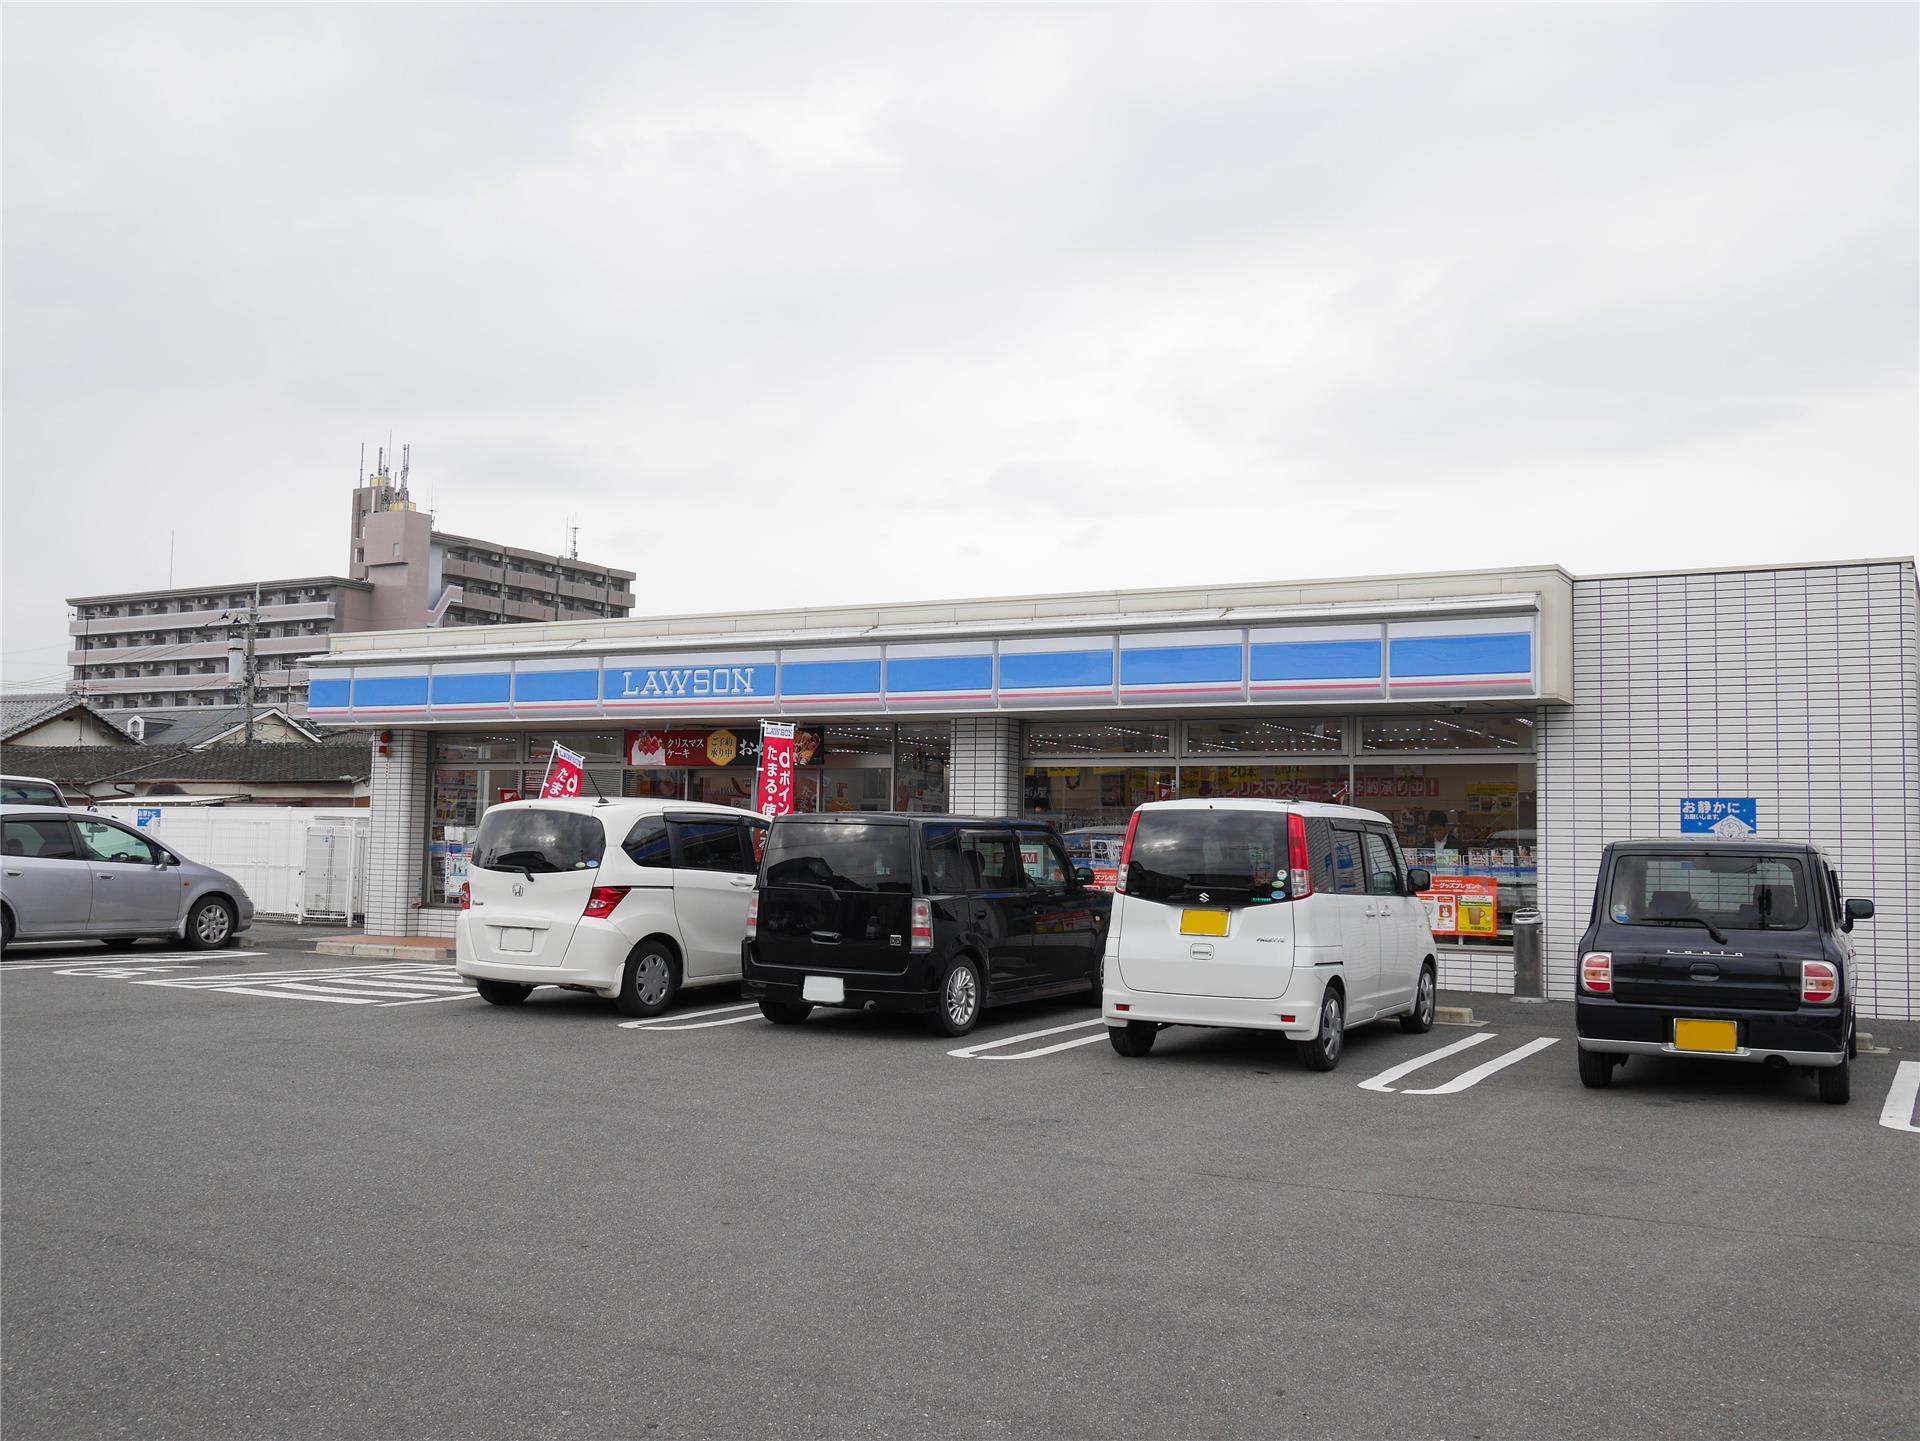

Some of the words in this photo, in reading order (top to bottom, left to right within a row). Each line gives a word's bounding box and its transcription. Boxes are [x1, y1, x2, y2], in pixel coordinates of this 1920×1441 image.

[622, 668, 755, 697] LAWSON
[765, 726, 793, 738] LAWSON
[667, 737, 704, 748] クリスマス
[710, 737, 734, 748] ご予約
[667, 748, 690, 759] ケーキ
[1682, 800, 1740, 814] お静かに
